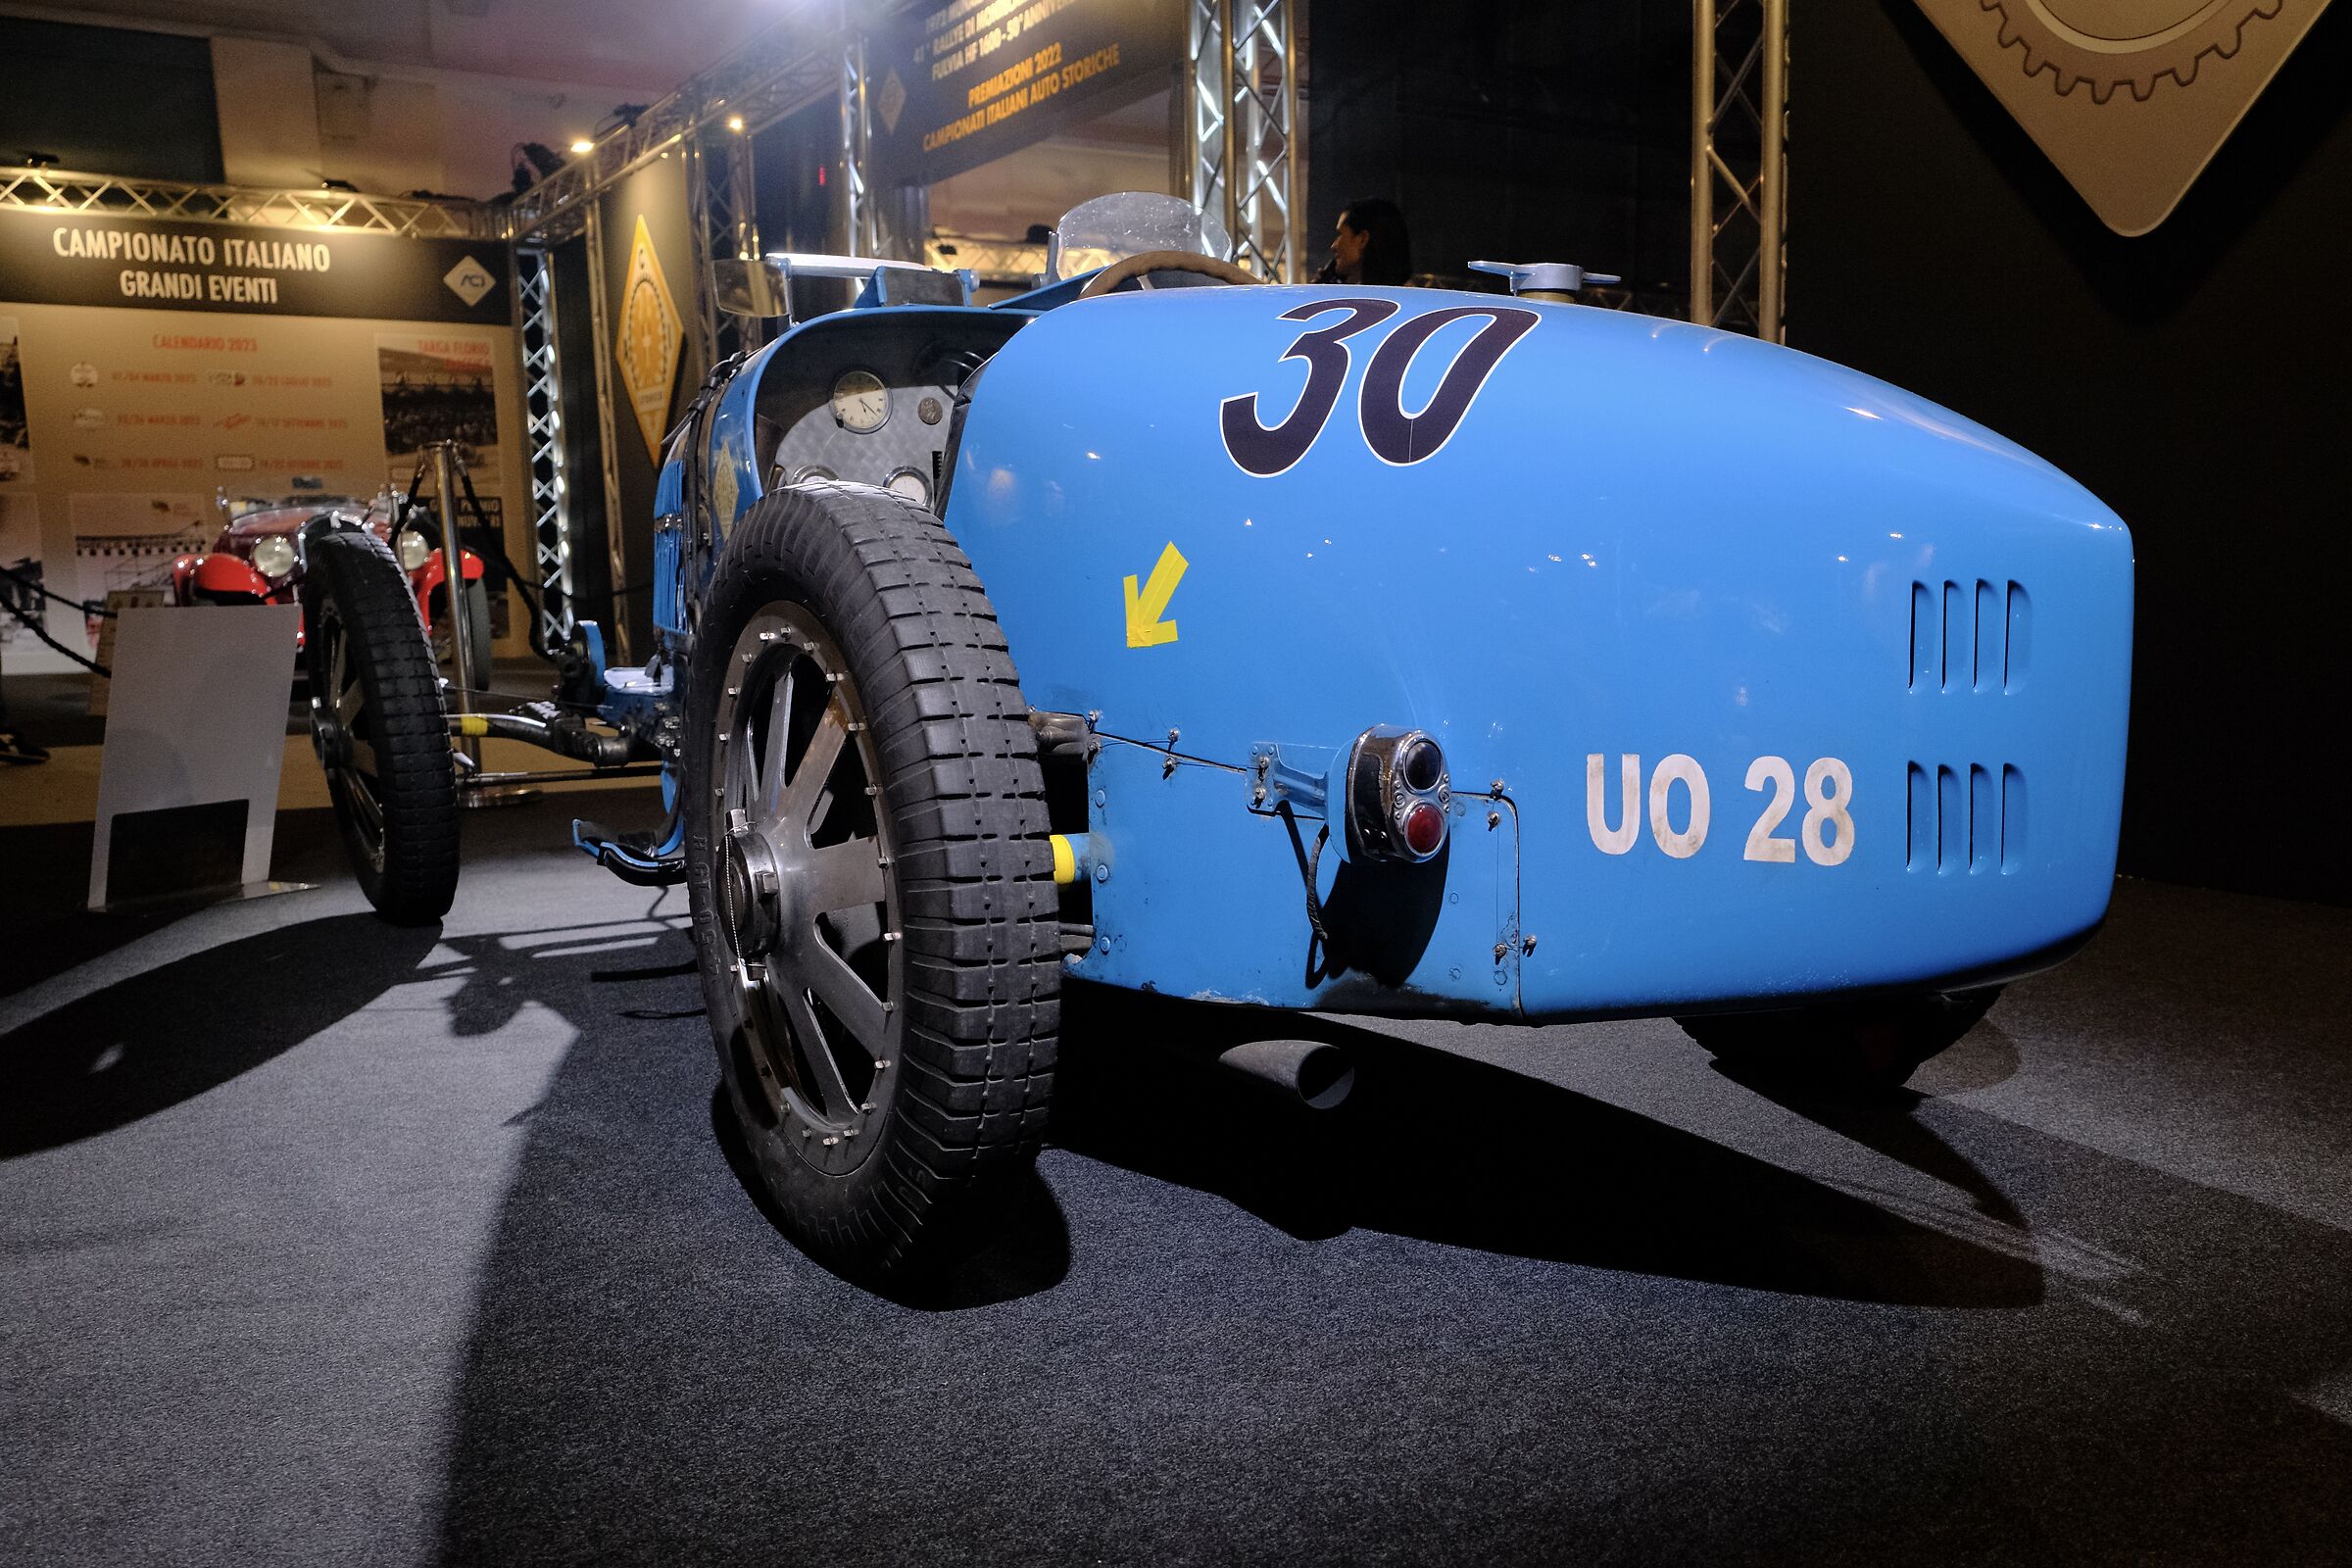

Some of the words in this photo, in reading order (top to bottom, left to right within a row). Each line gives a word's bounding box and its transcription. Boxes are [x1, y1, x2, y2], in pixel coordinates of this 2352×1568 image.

[932, 50, 964, 80] FULVIA
[965, 41, 978, 65] HF
[968, 57, 1033, 109] PREMIAZIONI
[1034, 42, 1062, 74] 2022
[923, 109, 987, 152] CAMPIONATI
[987, 87, 1029, 125] ITALIANI
[1030, 72, 1061, 105] AUTO
[1061, 42, 1121, 90] STORICHE
[53, 226, 216, 266] CAMPIONATO
[223, 238, 330, 272] ITALIANO
[120, 270, 203, 301] GRANDI
[208, 274, 278, 305] EVENTI
[153, 334, 224, 351] CALENDARIO
[1218, 297, 1543, 478] 30
[1586, 753, 1710, 858] UO
[1743, 756, 1855, 866] 28
